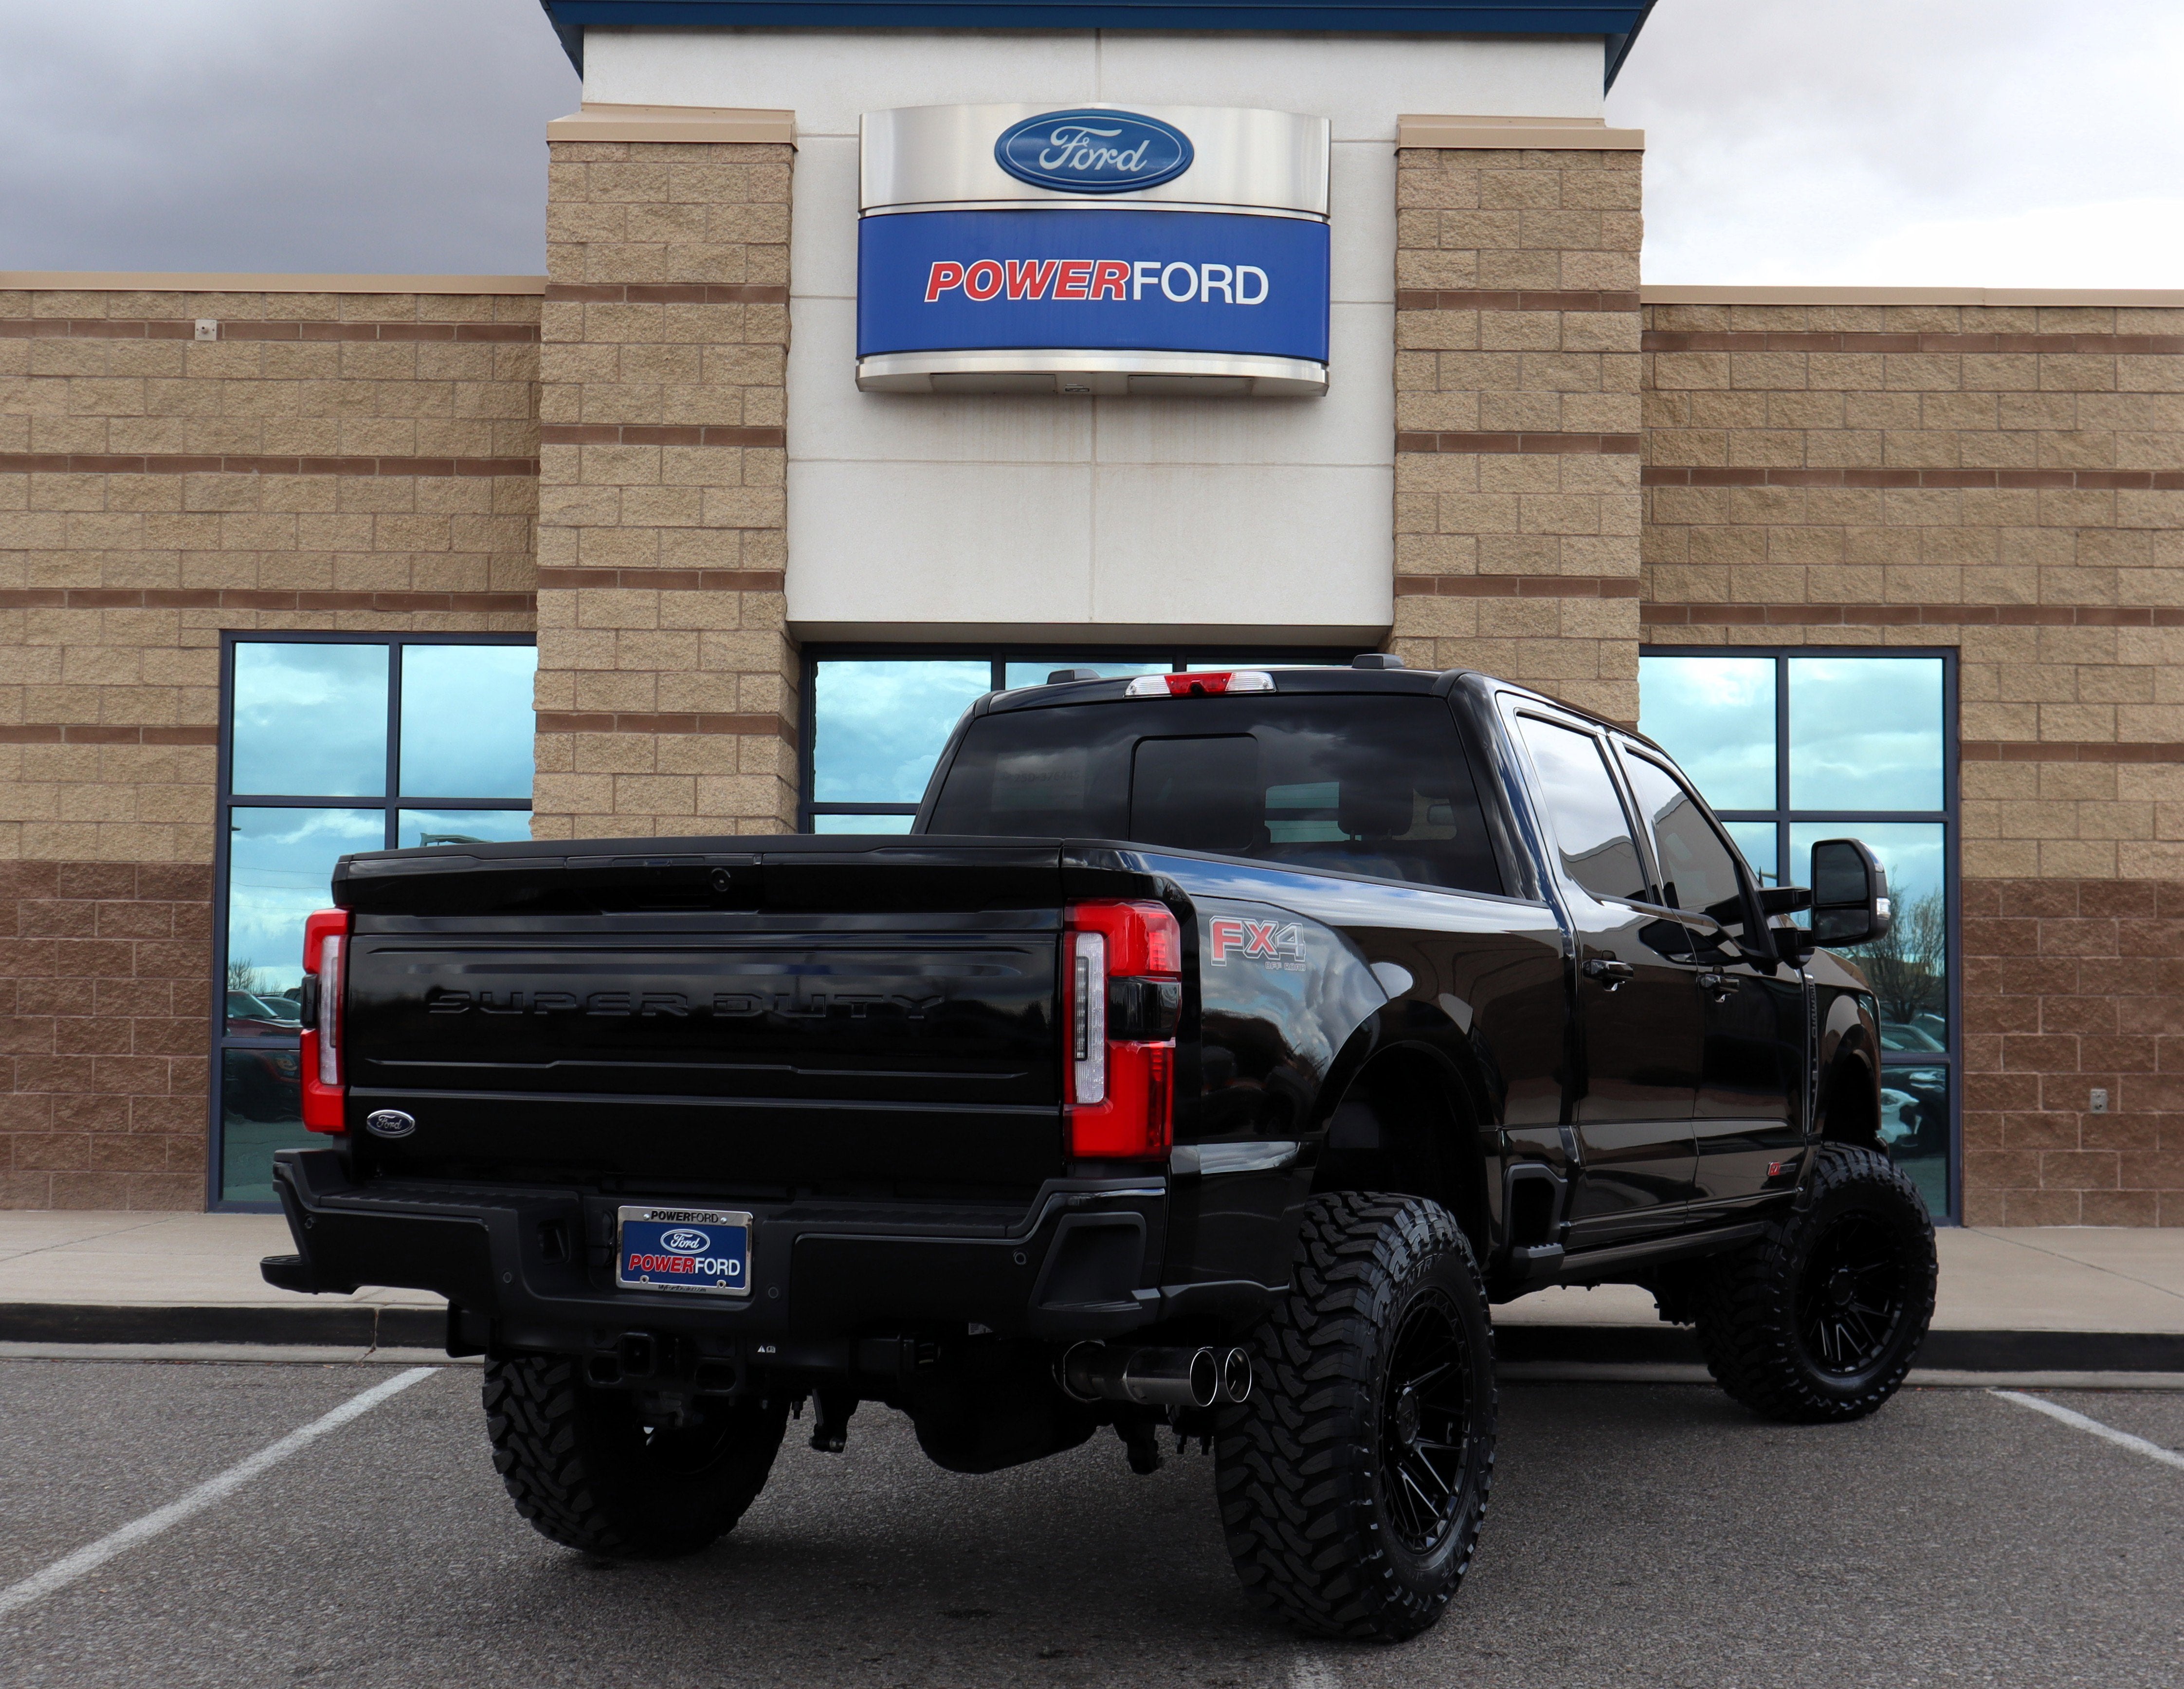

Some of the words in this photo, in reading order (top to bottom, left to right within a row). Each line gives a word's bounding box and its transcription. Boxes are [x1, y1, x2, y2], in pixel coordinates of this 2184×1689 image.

[1039, 126, 1150, 172] Ford
[924, 259, 1269, 304] POWERFORD
[1209, 916, 1306, 966] FX4
[1265, 961, 1282, 970] OFF
[1284, 962, 1306, 972] ROAD
[428, 990, 689, 1016] SUPER
[712, 992, 945, 1019] DUTY
[376, 1115, 402, 1129] Ford
[651, 1211, 719, 1223] POWERFORD
[670, 1233, 700, 1249] Ford
[628, 1254, 741, 1276] POWERFORD
